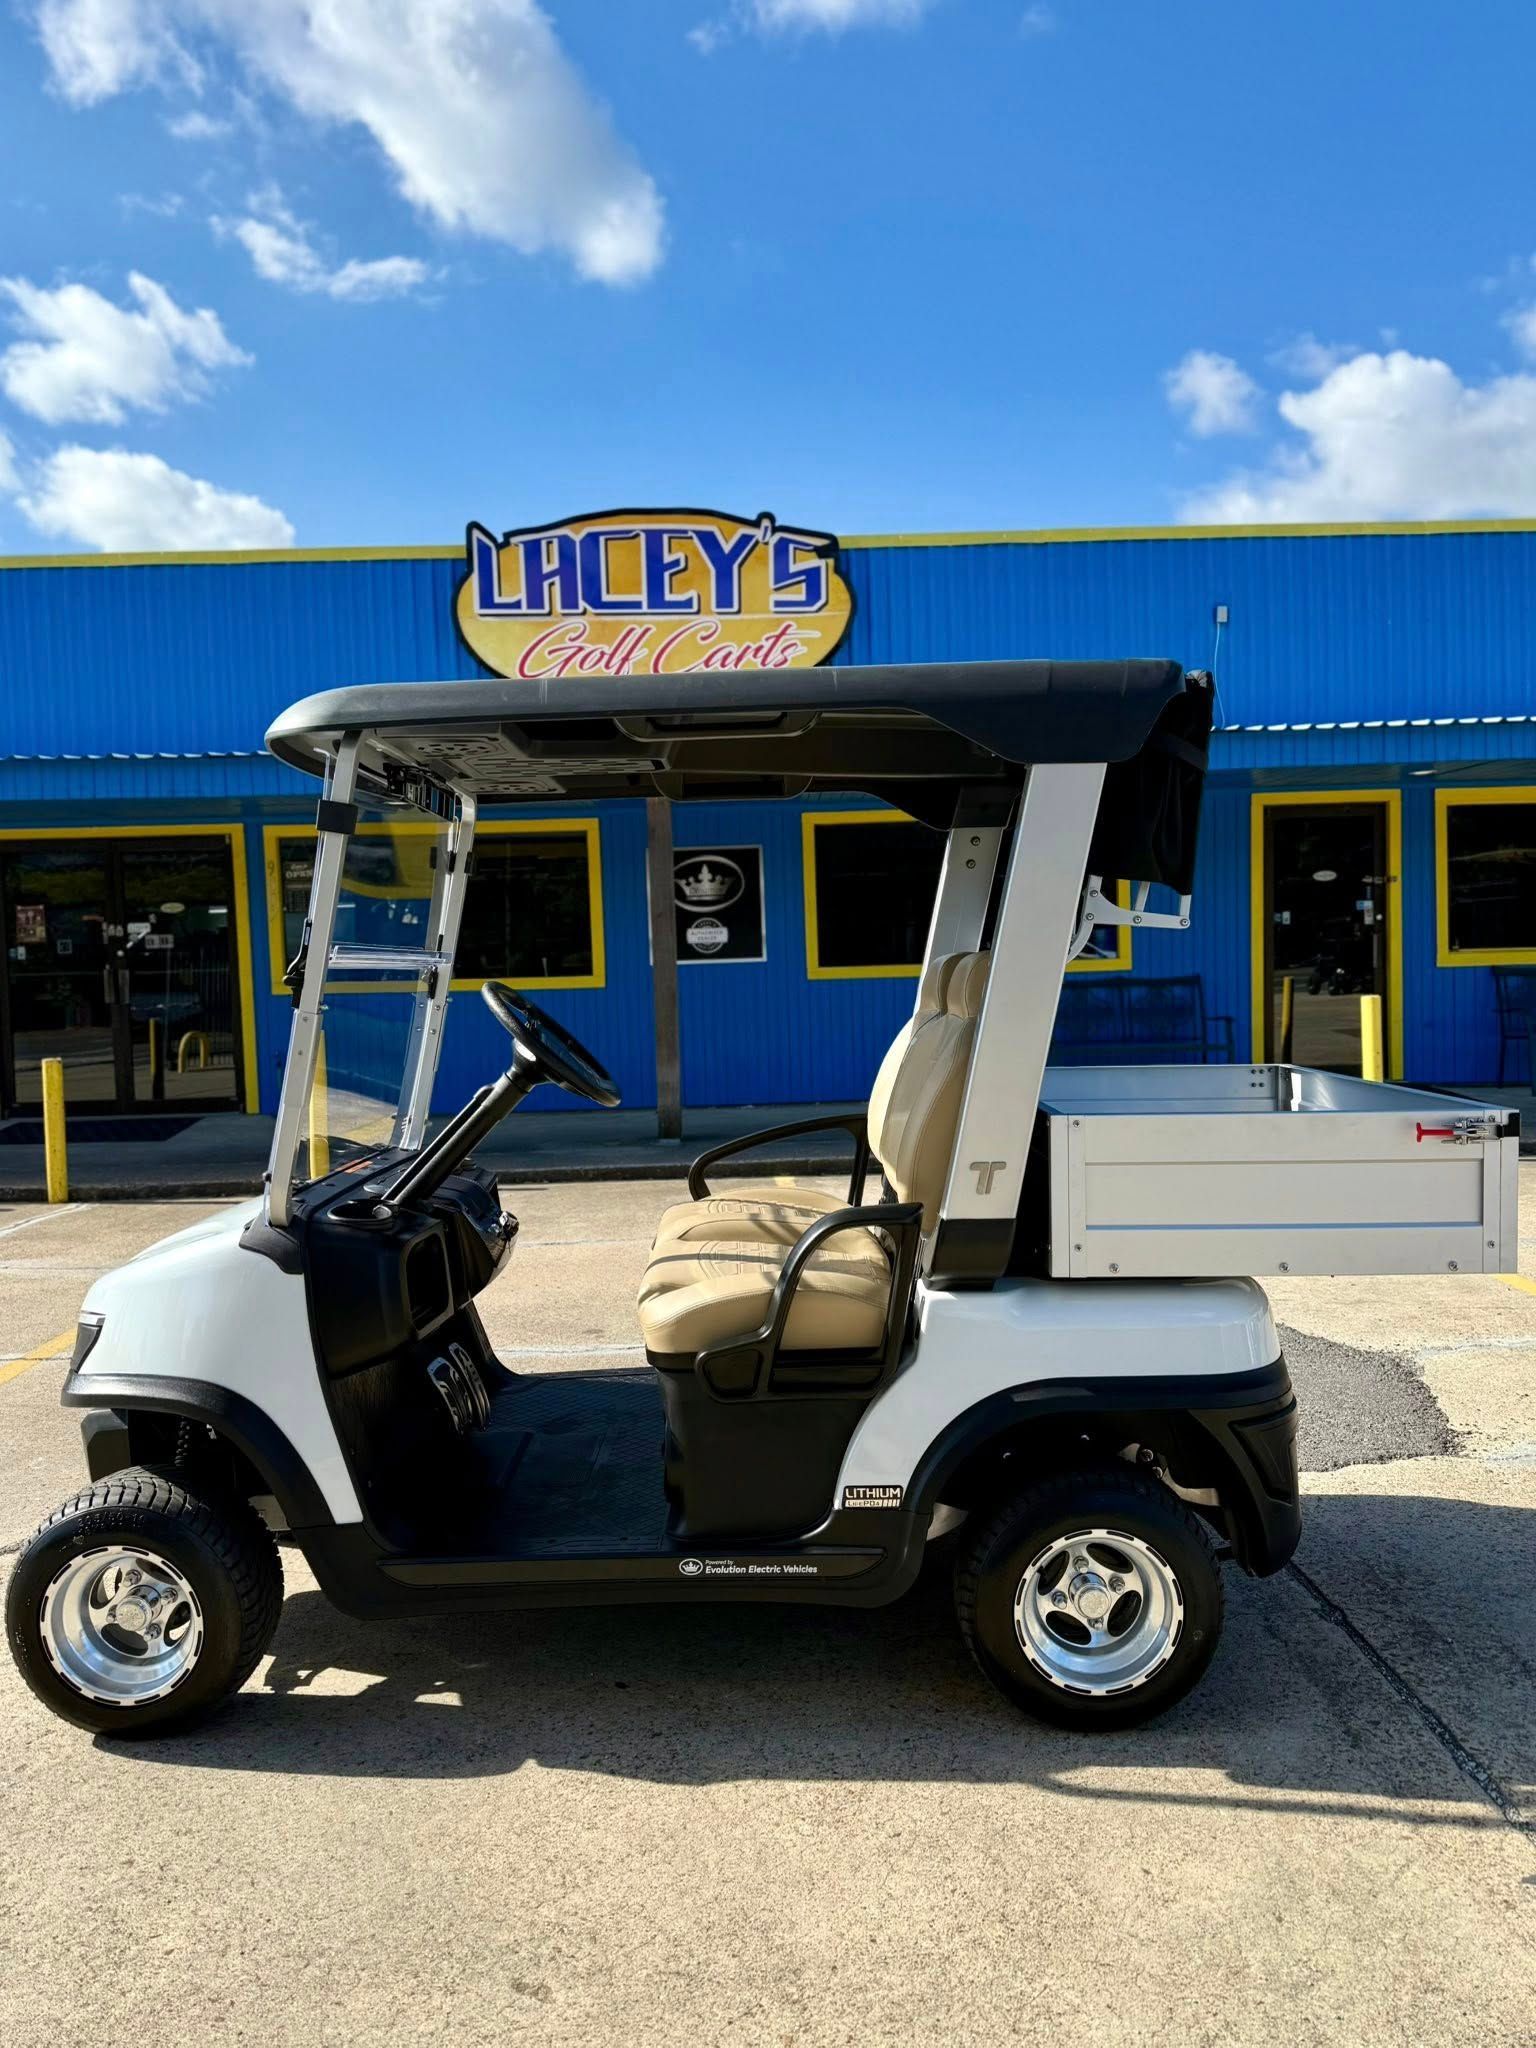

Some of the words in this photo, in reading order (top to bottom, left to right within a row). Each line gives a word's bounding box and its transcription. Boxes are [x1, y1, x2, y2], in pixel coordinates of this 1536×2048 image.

[472, 517, 833, 617] LACEY'S
[516, 619, 656, 679] Golf
[651, 618, 821, 675] Carts
[969, 1161, 1007, 1195] T
[845, 1487, 901, 1498] LITHIUM
[705, 1565, 746, 1574] Evolution
[748, 1565, 781, 1574] Electric
[783, 1564, 818, 1574] Vehicles
